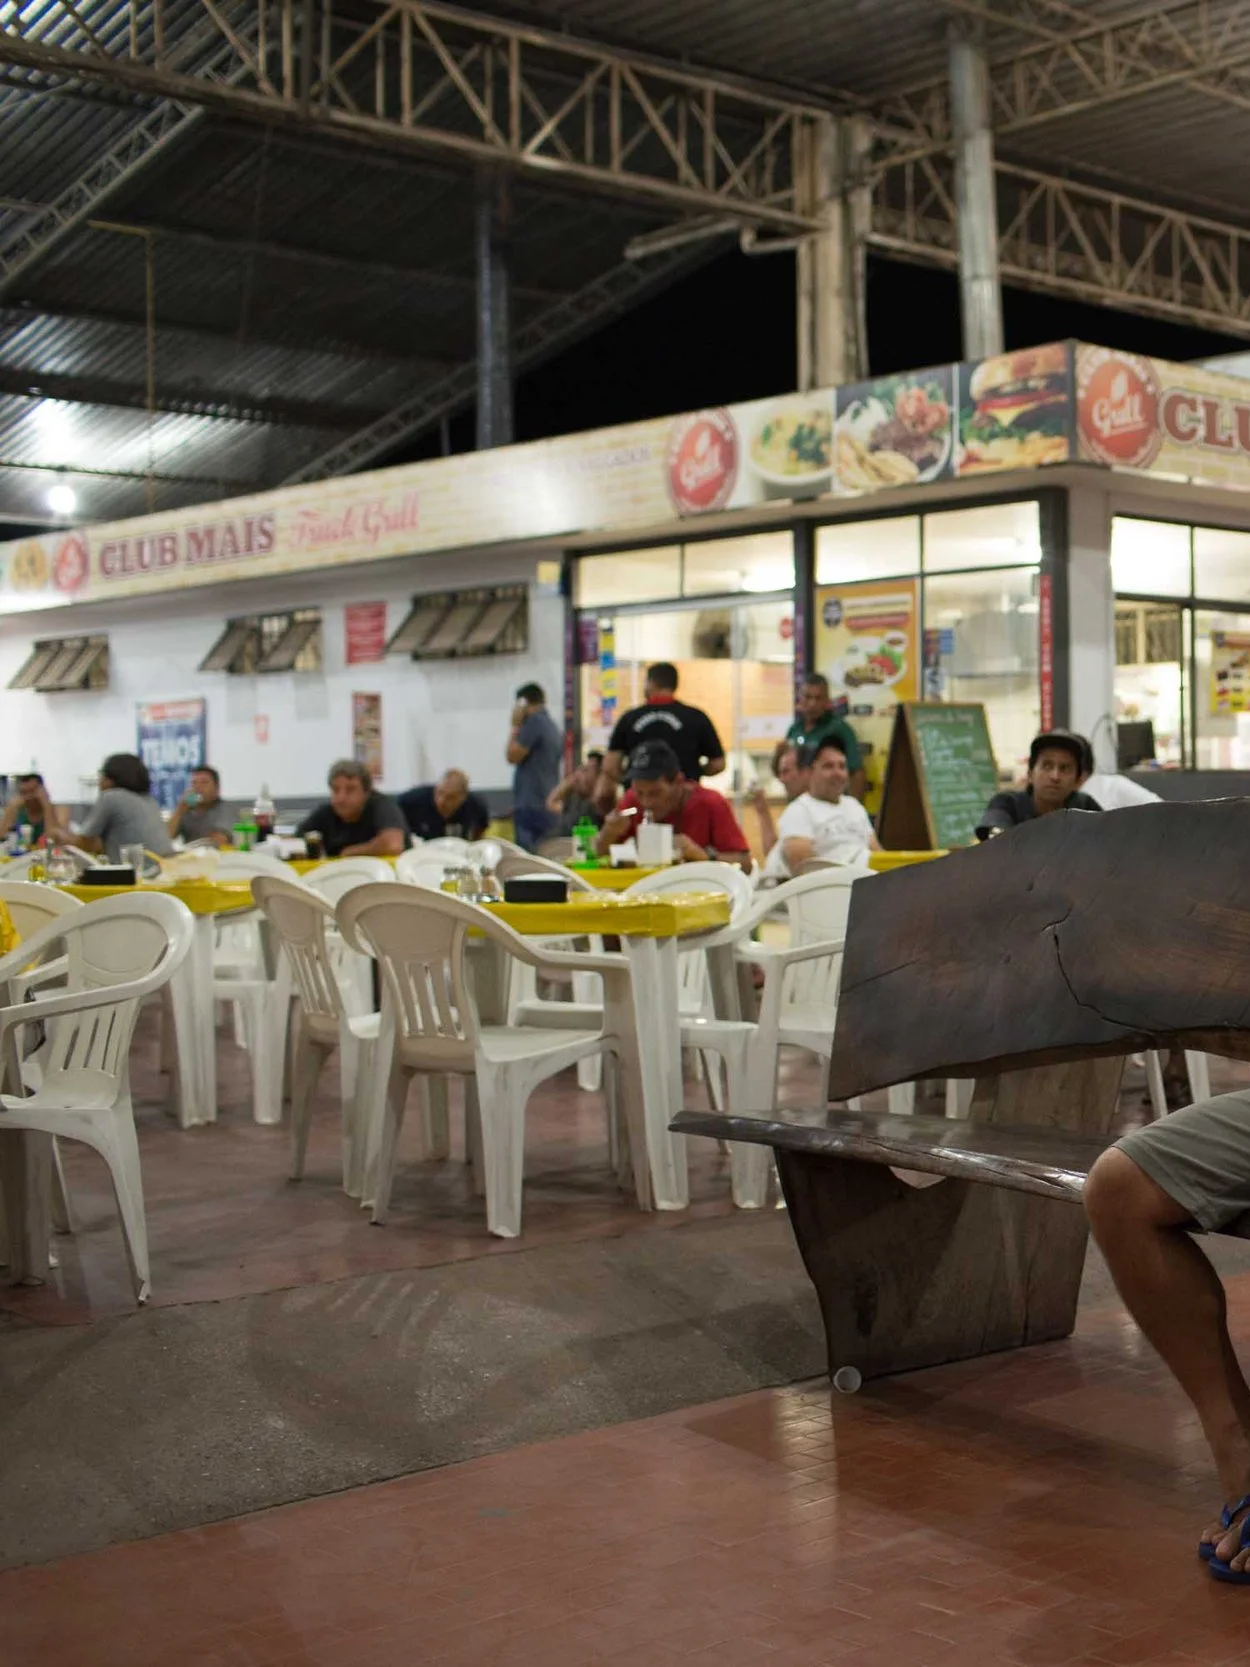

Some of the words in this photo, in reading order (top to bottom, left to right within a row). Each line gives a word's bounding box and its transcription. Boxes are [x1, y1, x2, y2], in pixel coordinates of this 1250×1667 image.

[101, 531, 180, 576] CLUB
[186, 514, 275, 564] MAIS
[290, 506, 355, 547] Truck
[362, 494, 418, 545] Grill
